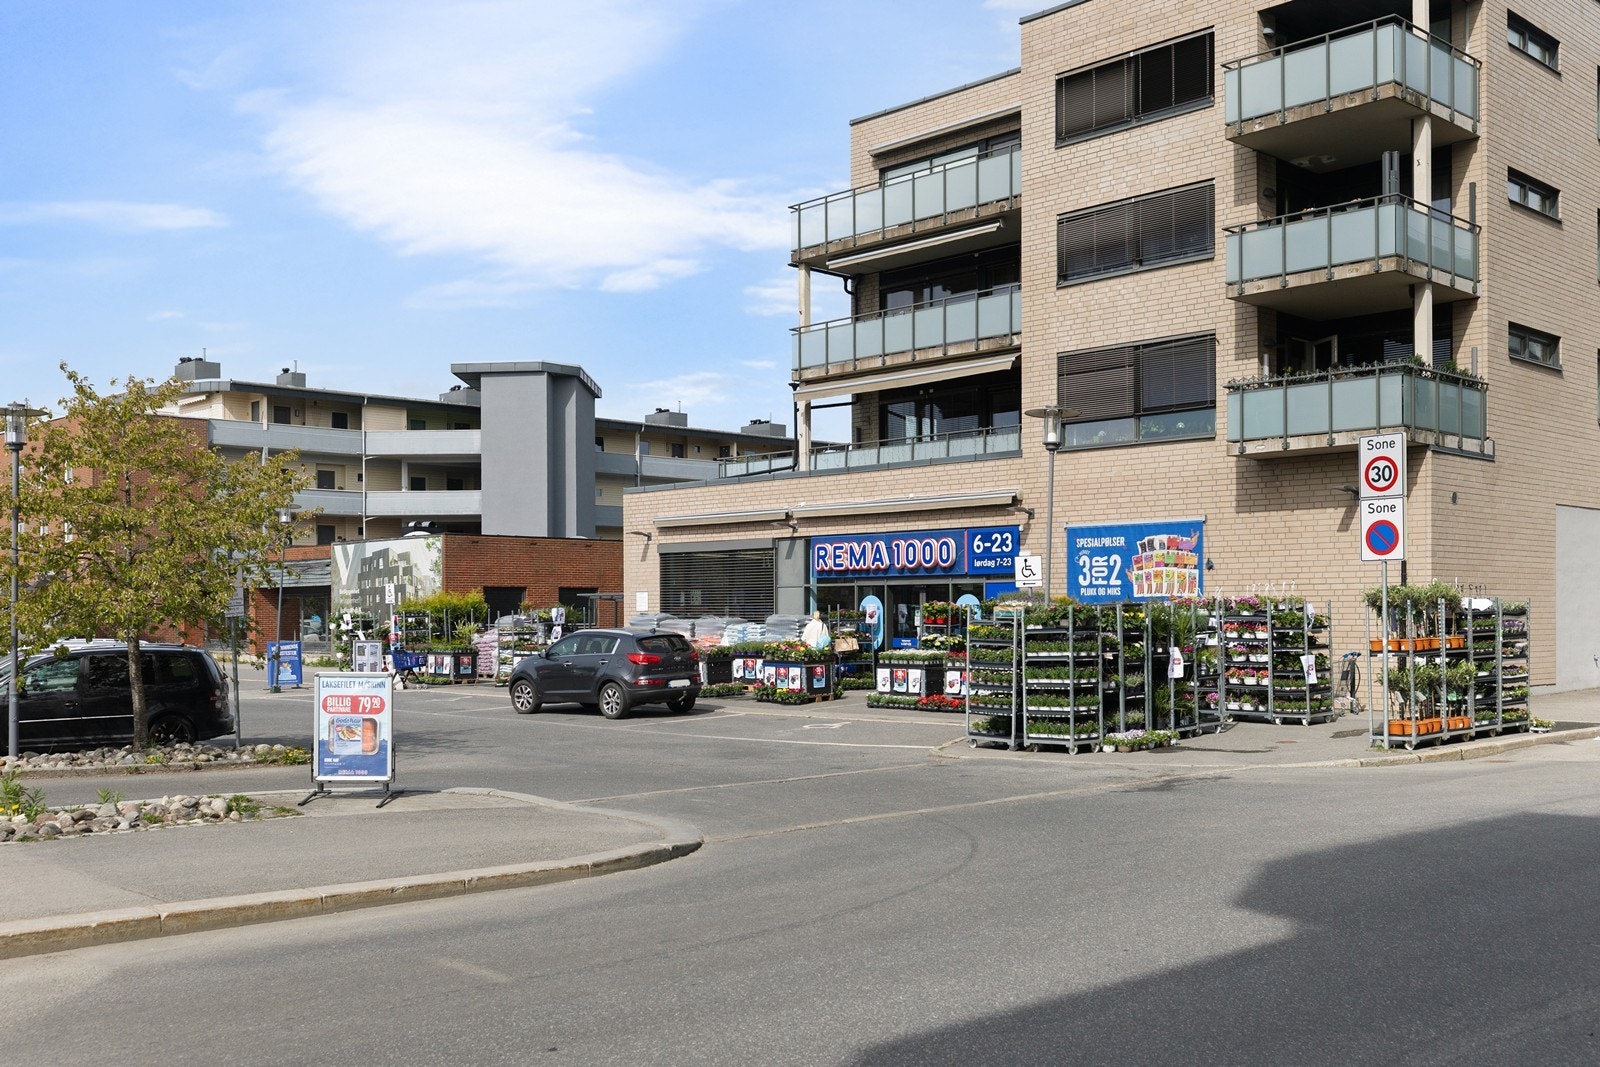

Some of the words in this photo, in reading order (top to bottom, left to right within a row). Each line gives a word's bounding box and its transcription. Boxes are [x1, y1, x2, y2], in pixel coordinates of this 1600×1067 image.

[1367, 440, 1396, 450] Sone
[1371, 465, 1392, 483] 30
[1368, 503, 1397, 514] Sone
[973, 533, 1012, 553] 6-23
[1076, 537, 1125, 548] SPESIALPØLSER
[815, 541, 889, 571] REMA
[893, 537, 955, 568] 1000
[974, 559, 995, 568] lørdag
[996, 558, 1012, 566] 7-23
[1078, 555, 1090, 586] 3
[1091, 556, 1108, 585] FOR
[1109, 554, 1122, 586] 2
[1080, 588, 1097, 596] PLUKK
[1097, 588, 1106, 596] OG
[1107, 587, 1121, 596] MIKS
[322, 680, 356, 689] LAKSEFILET
[326, 696, 352, 707] BILLIG
